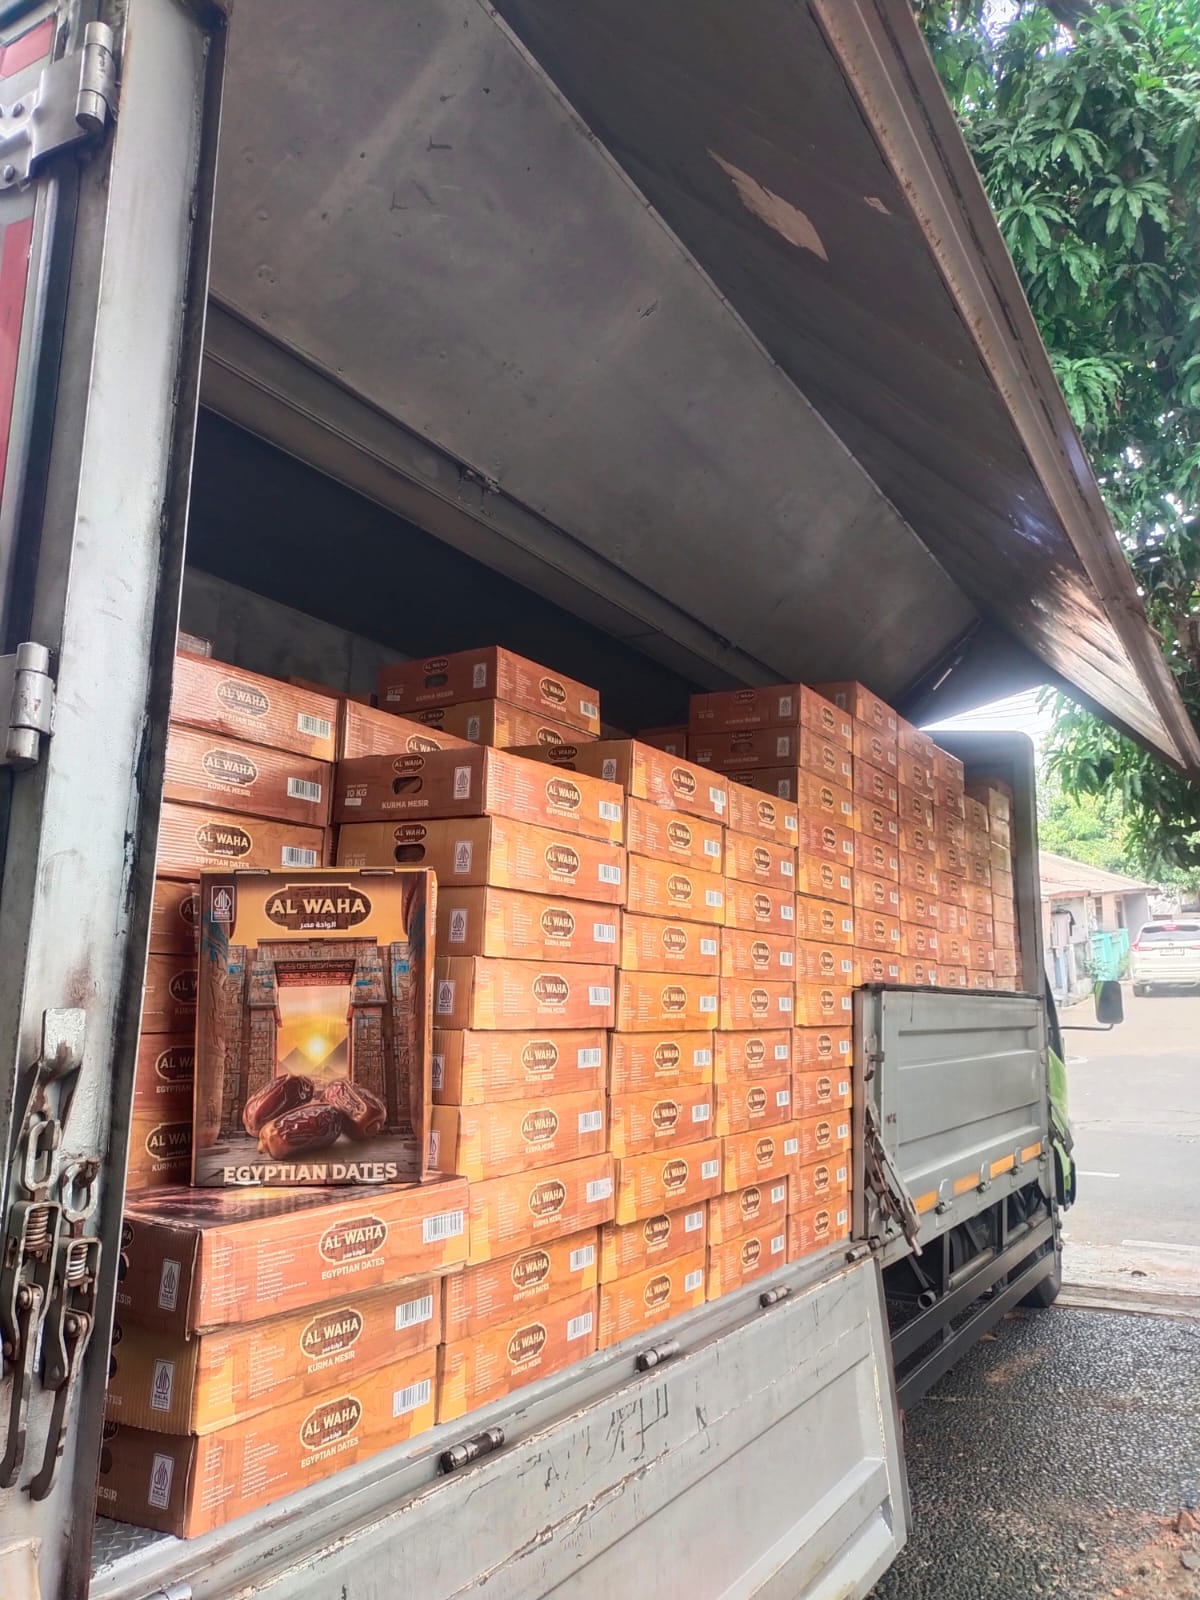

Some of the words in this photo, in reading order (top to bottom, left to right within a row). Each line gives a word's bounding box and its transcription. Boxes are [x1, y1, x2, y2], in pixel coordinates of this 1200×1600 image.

[219, 687, 234, 698] AL
[236, 692, 267, 709] WAHA
[205, 758, 222, 768] AL
[223, 759, 254, 776] WAHA
[404, 759, 423, 767] WAHA
[356, 789, 367, 797] KG
[548, 785, 558, 794] AL
[559, 787, 579, 800] WAHA
[382, 800, 406, 809] KURMA
[408, 800, 429, 808] MESIR
[199, 831, 214, 842] AL
[216, 833, 248, 847] WAHA
[405, 828, 426, 836] WAHA
[547, 852, 556, 862] AL
[558, 853, 578, 867] WAHA
[677, 882, 691, 891] WAHA
[270, 899, 297, 914] AL
[302, 899, 366, 914] WAHA
[542, 917, 552, 925] AL
[553, 917, 574, 929] WAHA
[664, 934, 671, 942] AL
[672, 935, 685, 943] WAHA
[534, 983, 544, 993] AL
[546, 983, 567, 993] WAHA
[671, 994, 685, 1002] WAHA
[523, 1051, 534, 1060] AL
[535, 1048, 556, 1060] WAHA
[664, 1050, 679, 1058] WAHA
[160, 1058, 176, 1068] AL
[523, 1122, 534, 1132] AL
[534, 1117, 556, 1129] WAHA
[150, 1136, 166, 1147] AL
[224, 1164, 326, 1182] EGYPTIAN
[332, 1162, 398, 1180] DATES
[664, 1170, 671, 1178] AL
[672, 1167, 686, 1177] WAHA
[531, 1195, 540, 1206] AL
[541, 1188, 563, 1202] WAHA
[646, 1227, 652, 1235] AL
[653, 1221, 669, 1232] WAHA
[323, 1236, 342, 1251] AL
[344, 1224, 383, 1243] WAHA
[321, 1263, 360, 1280] EGYPTIAN
[361, 1257, 385, 1272] DATES
[514, 1266, 524, 1277] AL
[525, 1258, 548, 1274] WAHA
[646, 1289, 653, 1297] AL
[653, 1284, 669, 1295] WAHA
[305, 1328, 321, 1345] AL
[323, 1317, 359, 1337] WAHA
[509, 1339, 520, 1352] AL
[521, 1330, 545, 1346] WAHA
[307, 1359, 332, 1375] KURMA
[334, 1351, 356, 1367] MESIR
[304, 1420, 321, 1438] AL
[323, 1405, 358, 1428] WAHA
[301, 1447, 336, 1468] EGYPTIAN
[337, 1436, 359, 1454] DATES
[98, 1486, 118, 1501] ESIR
